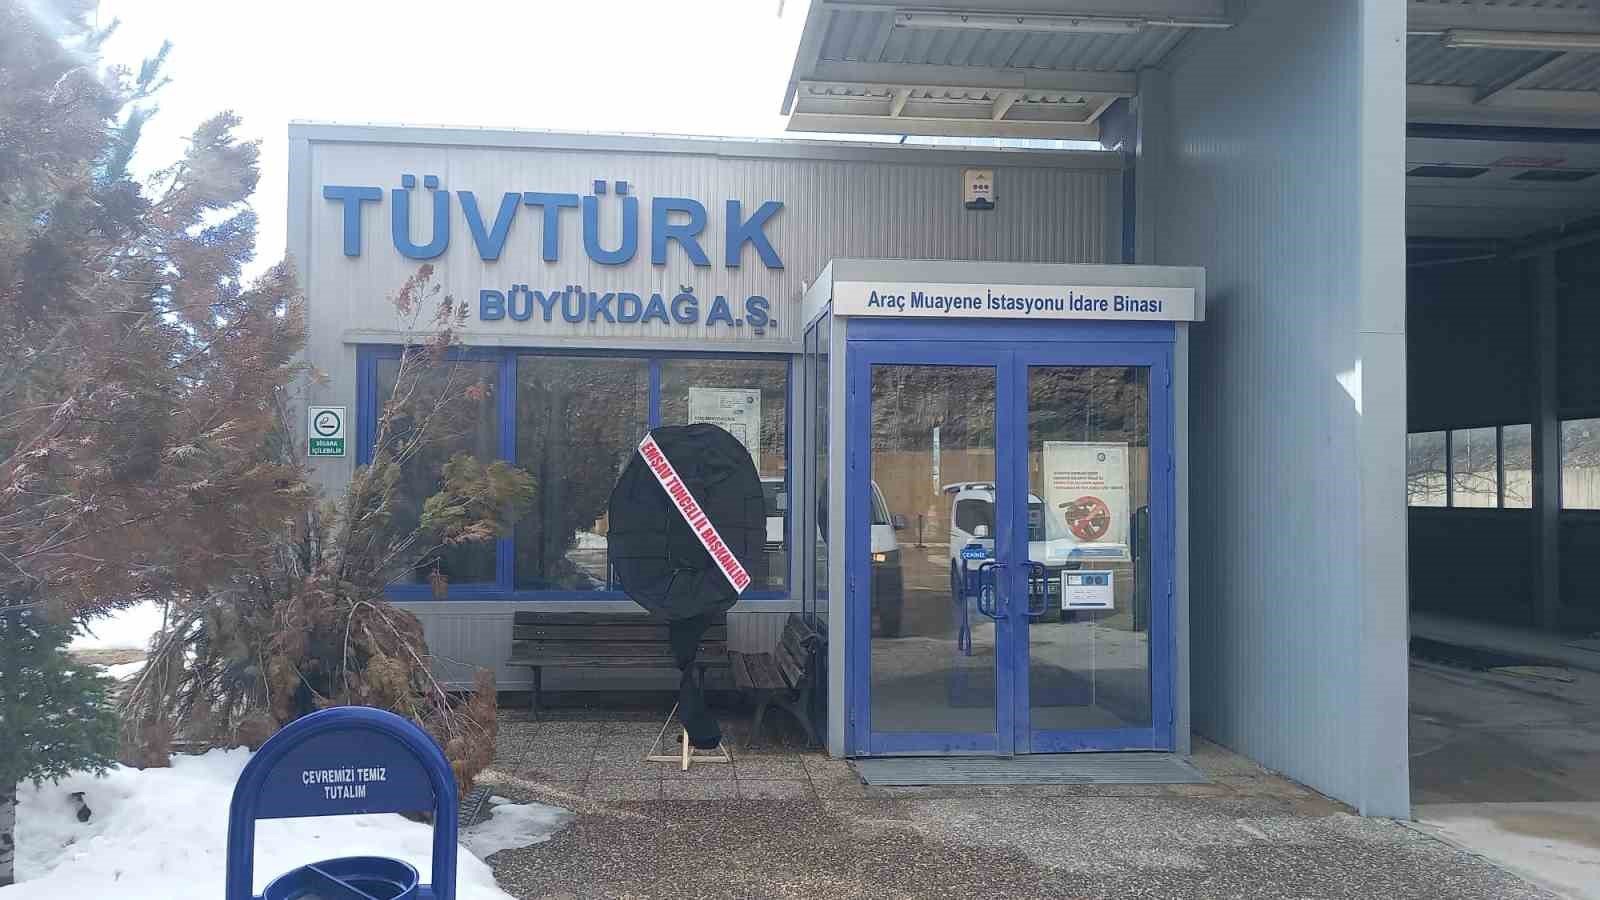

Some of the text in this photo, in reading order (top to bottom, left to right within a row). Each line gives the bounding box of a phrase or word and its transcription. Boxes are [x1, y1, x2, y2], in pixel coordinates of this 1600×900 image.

[323, 174, 785, 270] TÜVTÜRK
[479, 284, 777, 336] BÜYÜKDAĞ A.Ş.
[868, 288, 1163, 314] Araç Muayene İstasyonu İdare Binası
[302, 765, 386, 785] ÇEVREMİZİ TEMİZ
[324, 785, 366, 799] TUTALIM
